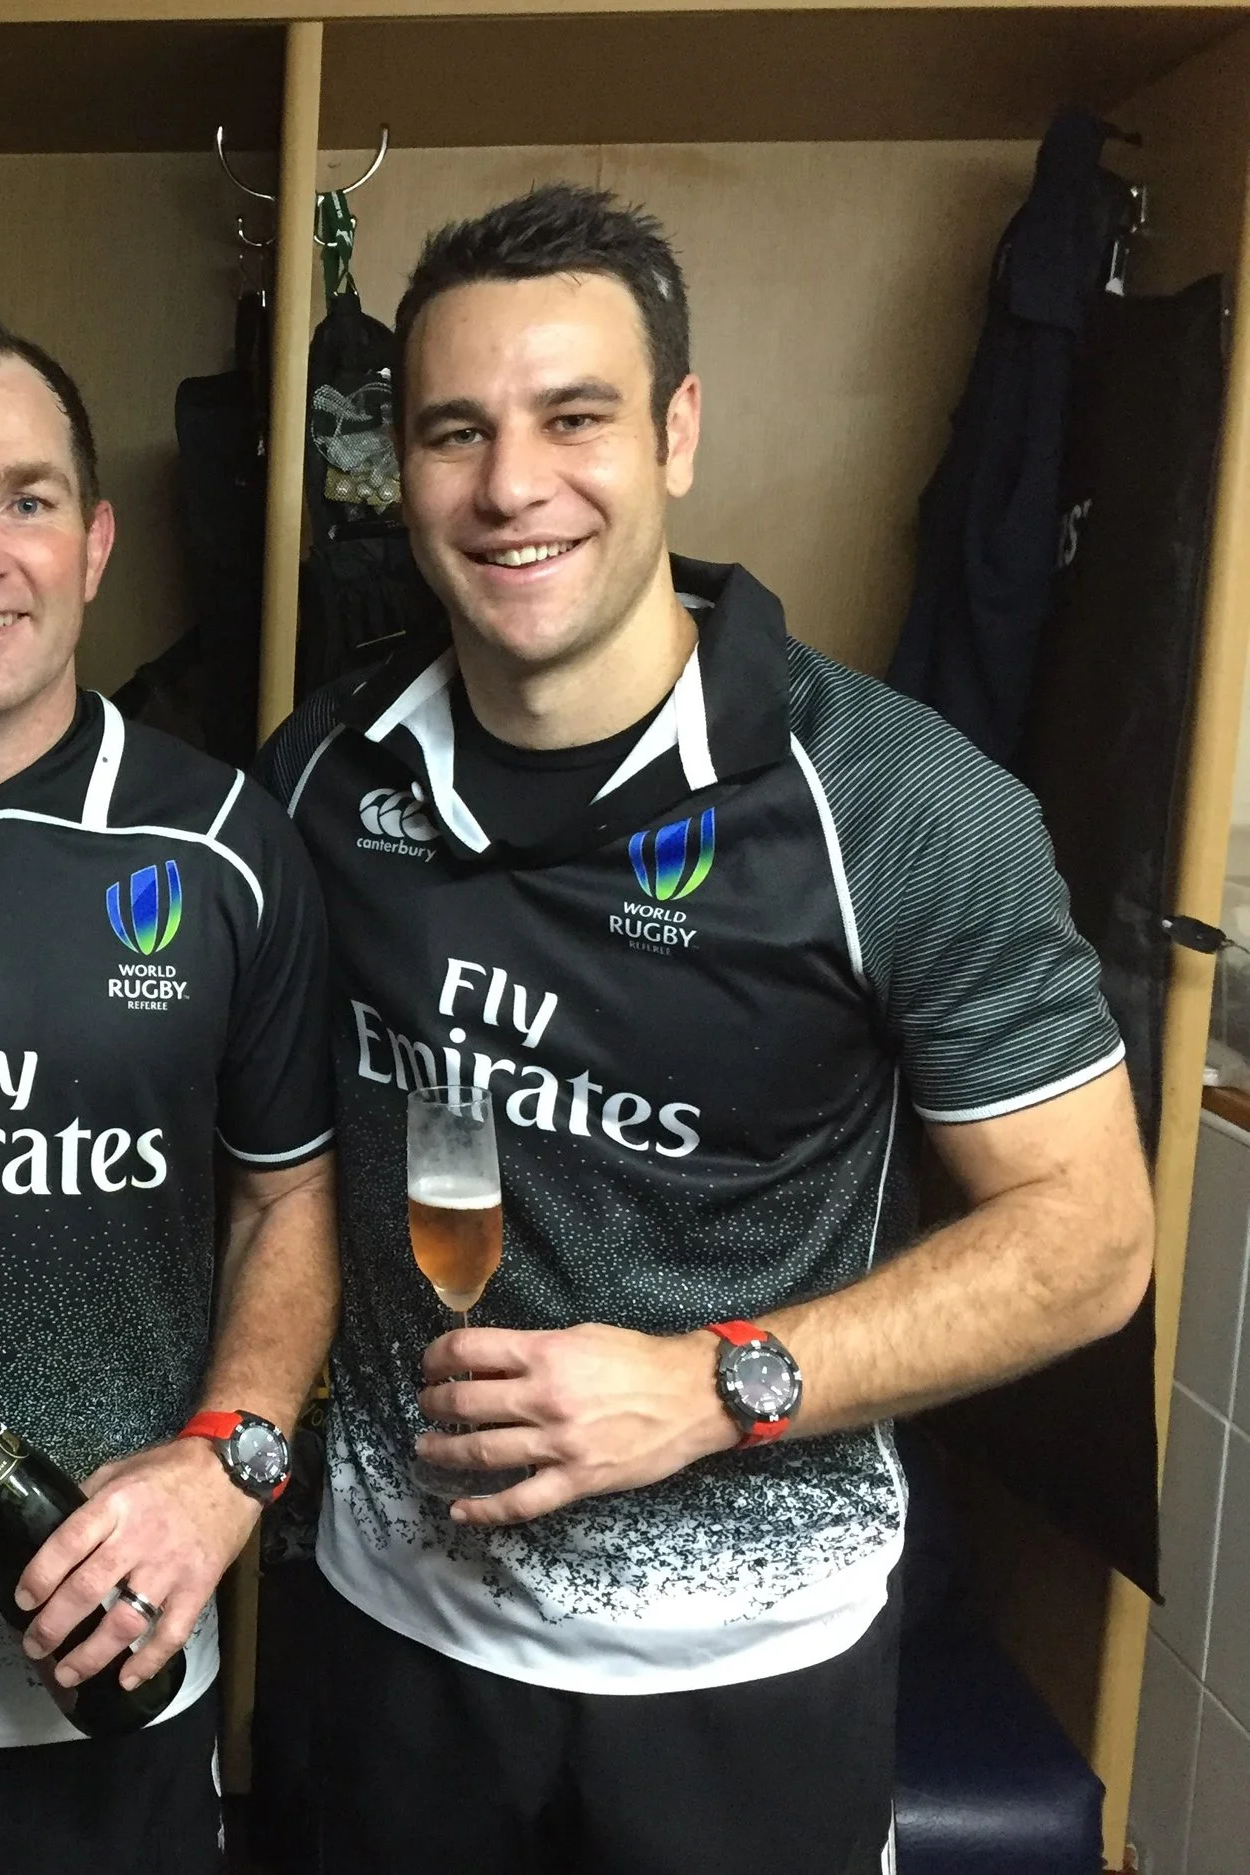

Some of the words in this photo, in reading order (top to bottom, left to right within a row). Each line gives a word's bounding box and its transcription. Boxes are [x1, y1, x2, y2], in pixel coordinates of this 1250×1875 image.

[356, 837, 437, 862] canterbury
[623, 901, 688, 924] WORLD
[609, 914, 697, 949] RUGBY
[118, 964, 177, 978] WORLD
[108, 978, 188, 1000] RUGBY
[127, 1000, 169, 1011] REFEREE
[438, 957, 559, 1048] Fly
[350, 999, 702, 1158] Emirates
